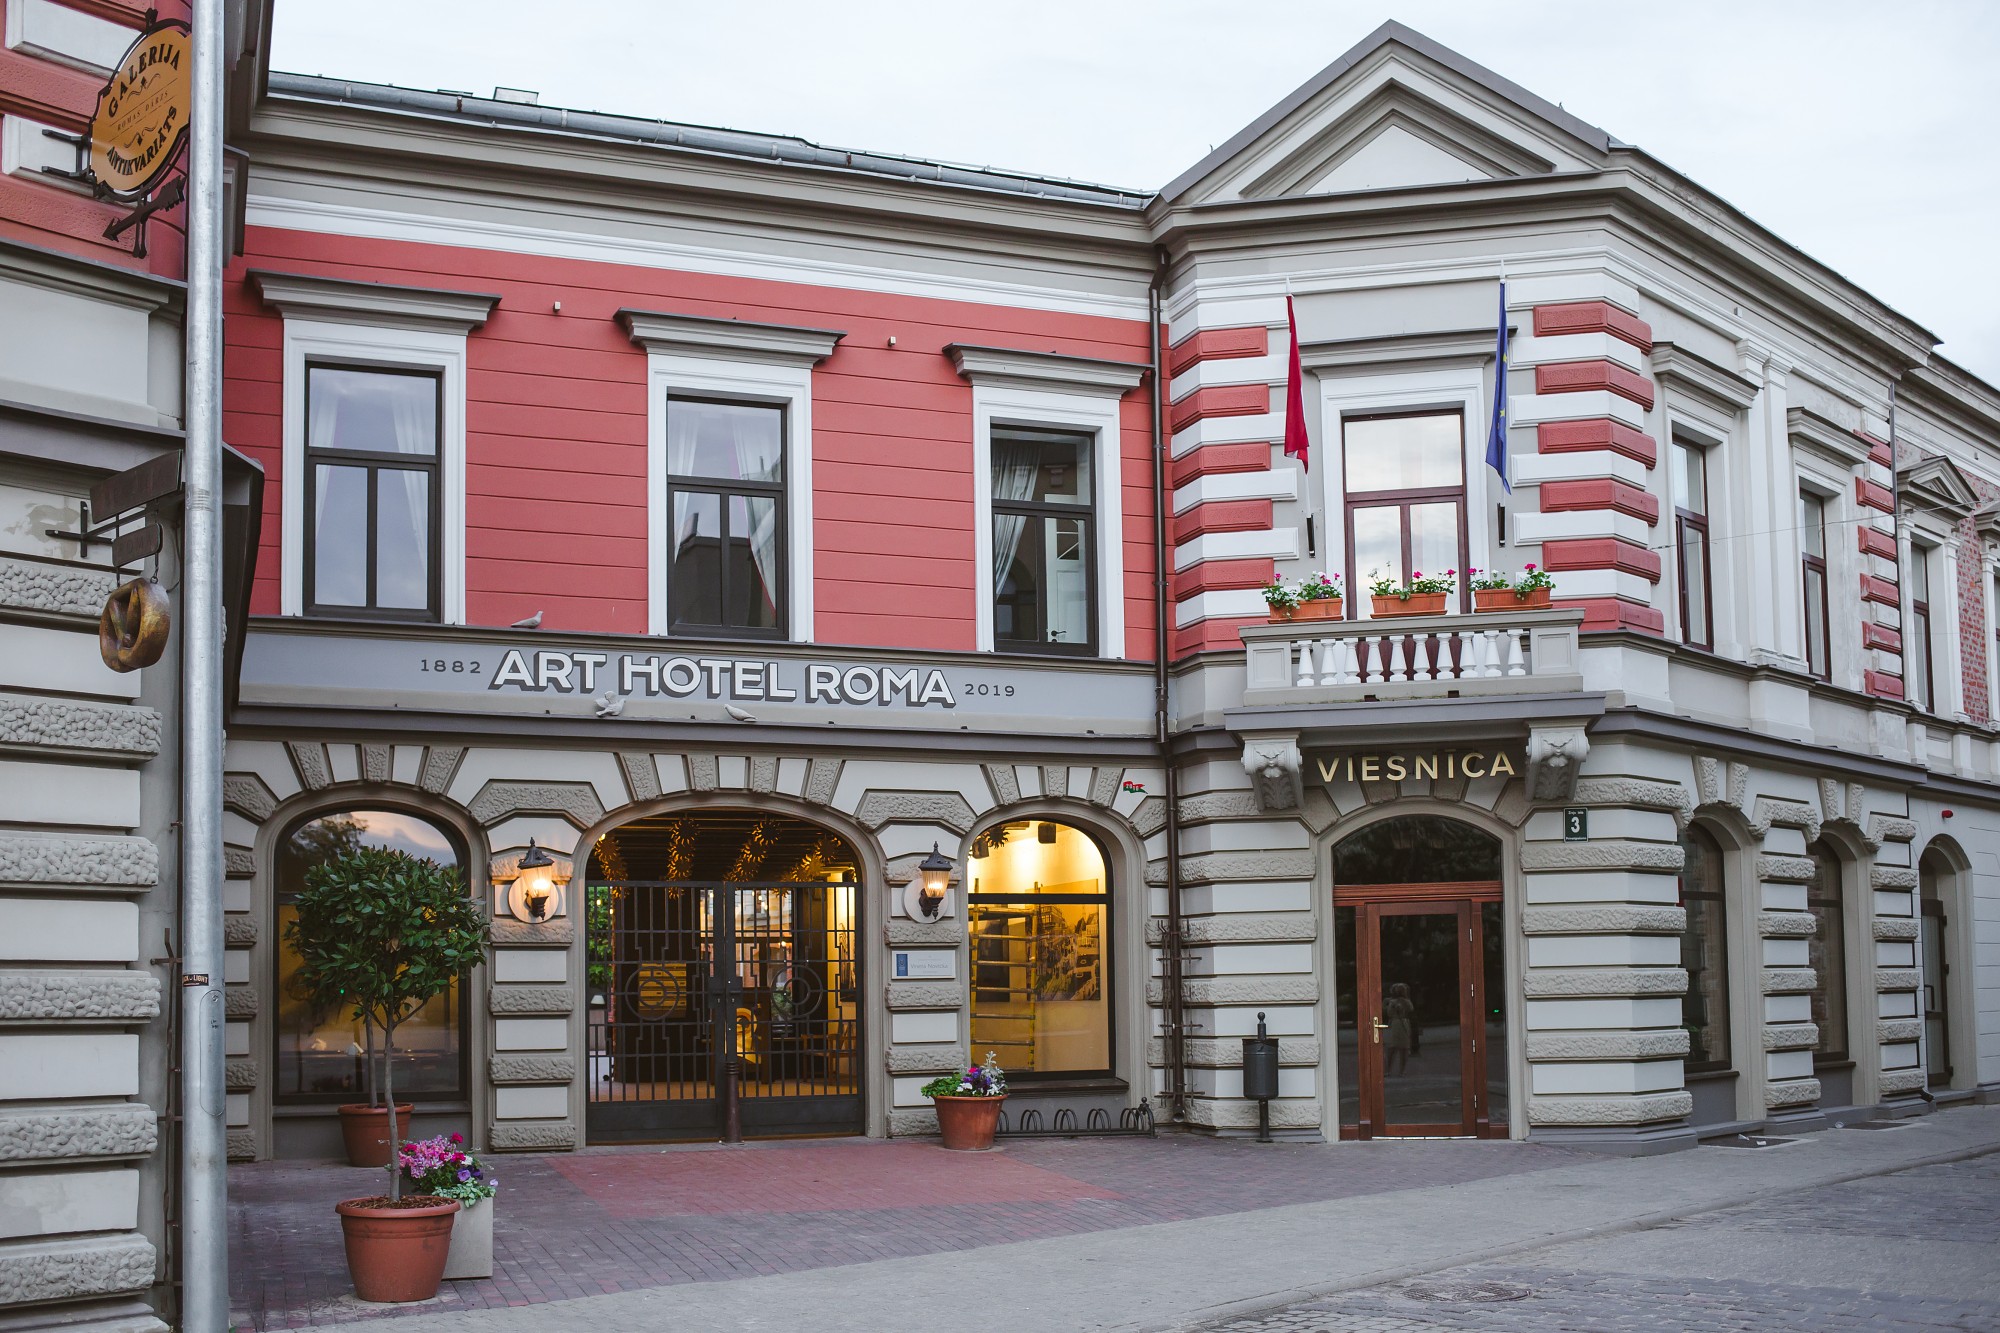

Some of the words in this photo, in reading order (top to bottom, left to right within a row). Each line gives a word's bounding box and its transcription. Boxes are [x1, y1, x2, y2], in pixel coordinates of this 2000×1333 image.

[108, 43, 180, 118] GALERIJA
[420, 659, 481, 674] 1882
[487, 649, 607, 694] ART
[618, 654, 797, 703] HOTEL
[805, 664, 957, 709] ROMA
[964, 683, 1016, 698] 2019
[1316, 748, 1516, 783] VIESNĪCA
[1570, 816, 1581, 834] 3
